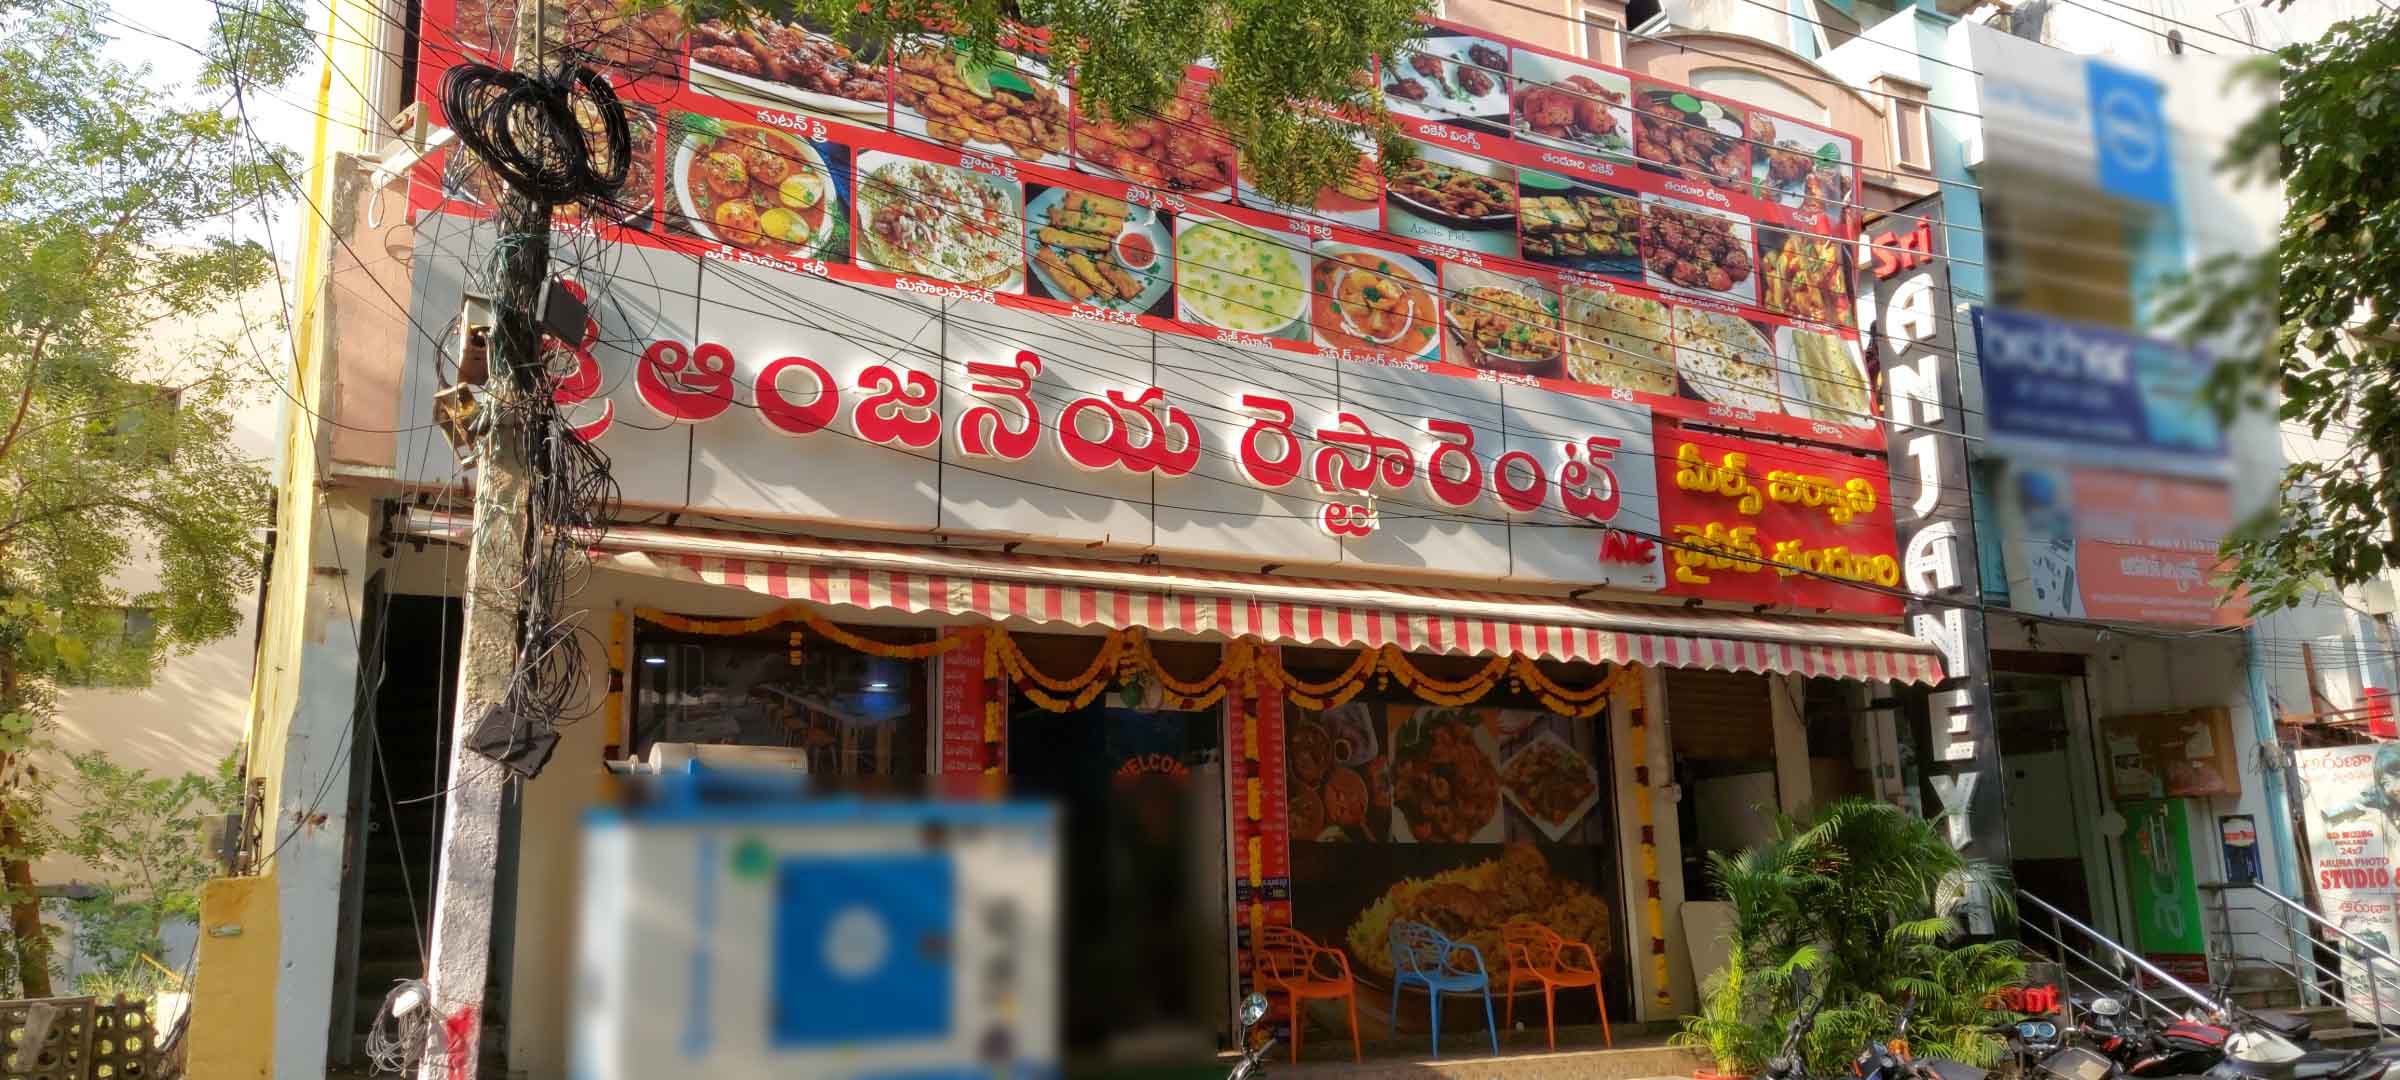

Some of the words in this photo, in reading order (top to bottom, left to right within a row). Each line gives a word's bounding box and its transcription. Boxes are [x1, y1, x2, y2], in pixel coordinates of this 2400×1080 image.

[634, 338, 1200, 477] ఆంజనేయ
[1236, 393, 1622, 538] రెస్టారెంట్
[1676, 442, 1763, 516] మీల్స్
[1772, 538, 1900, 588] తందూరి
[2321, 867, 2389, 890] STUDIO
[2354, 857, 2389, 866] PHOTO
